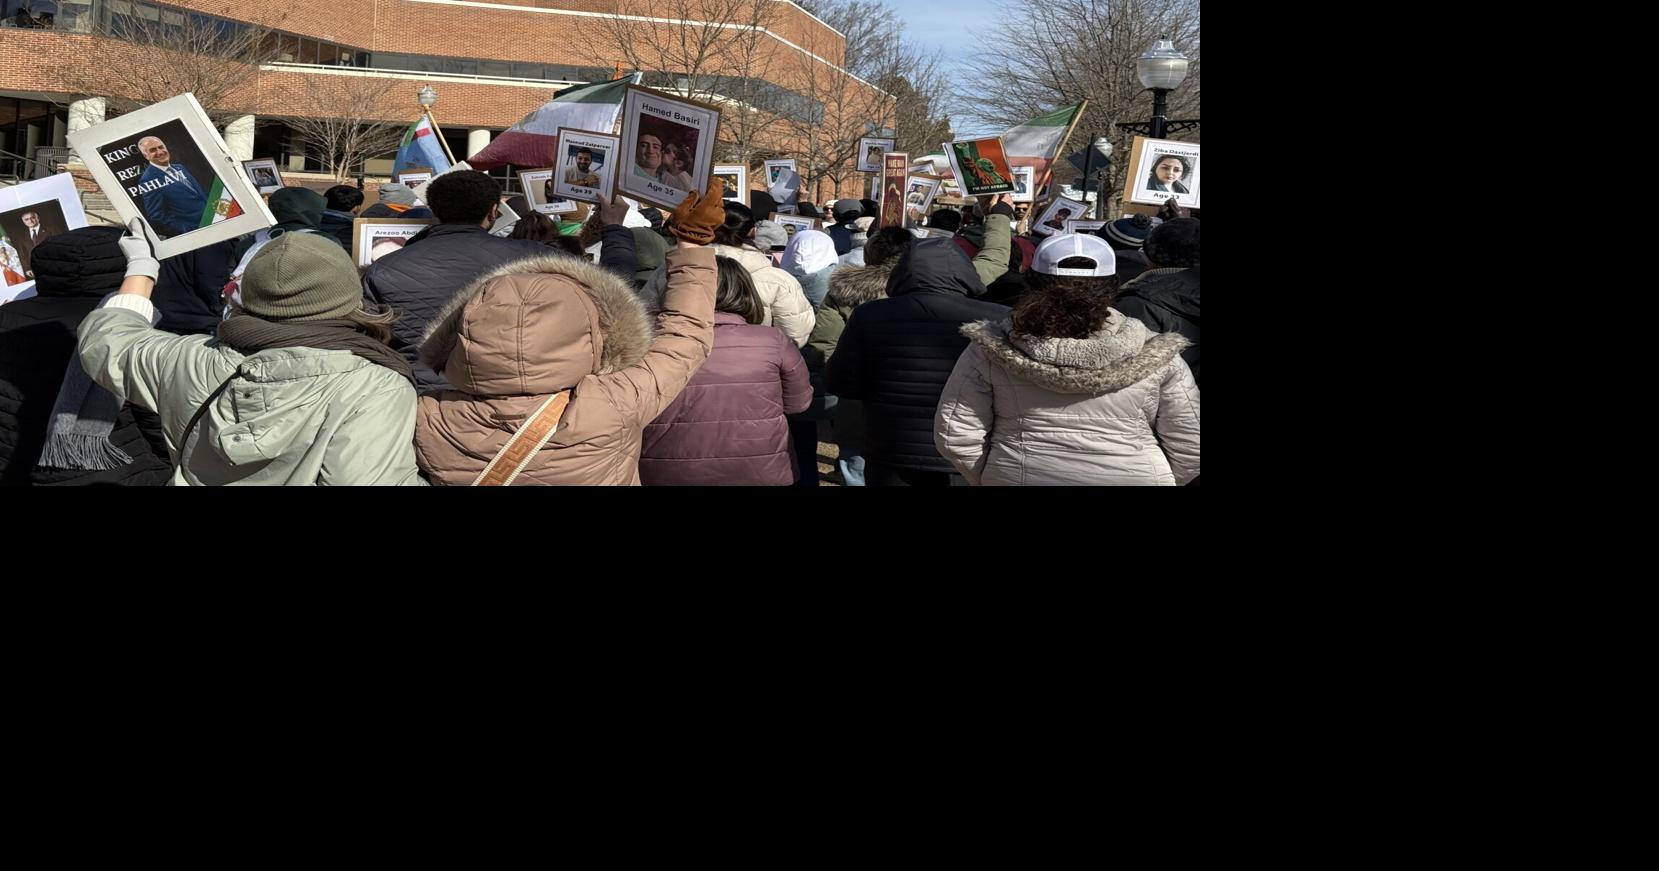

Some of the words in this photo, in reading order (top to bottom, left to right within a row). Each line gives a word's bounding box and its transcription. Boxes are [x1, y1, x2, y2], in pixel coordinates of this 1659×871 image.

[641, 103, 672, 117] Hamed
[673, 111, 700, 126] Basiri
[1168, 149, 1199, 157] Dastjerdi
[128, 170, 187, 197] PAHLAVI
[647, 182, 663, 193] Age
[664, 187, 675, 197] 35
[1153, 192, 1169, 200] Age
